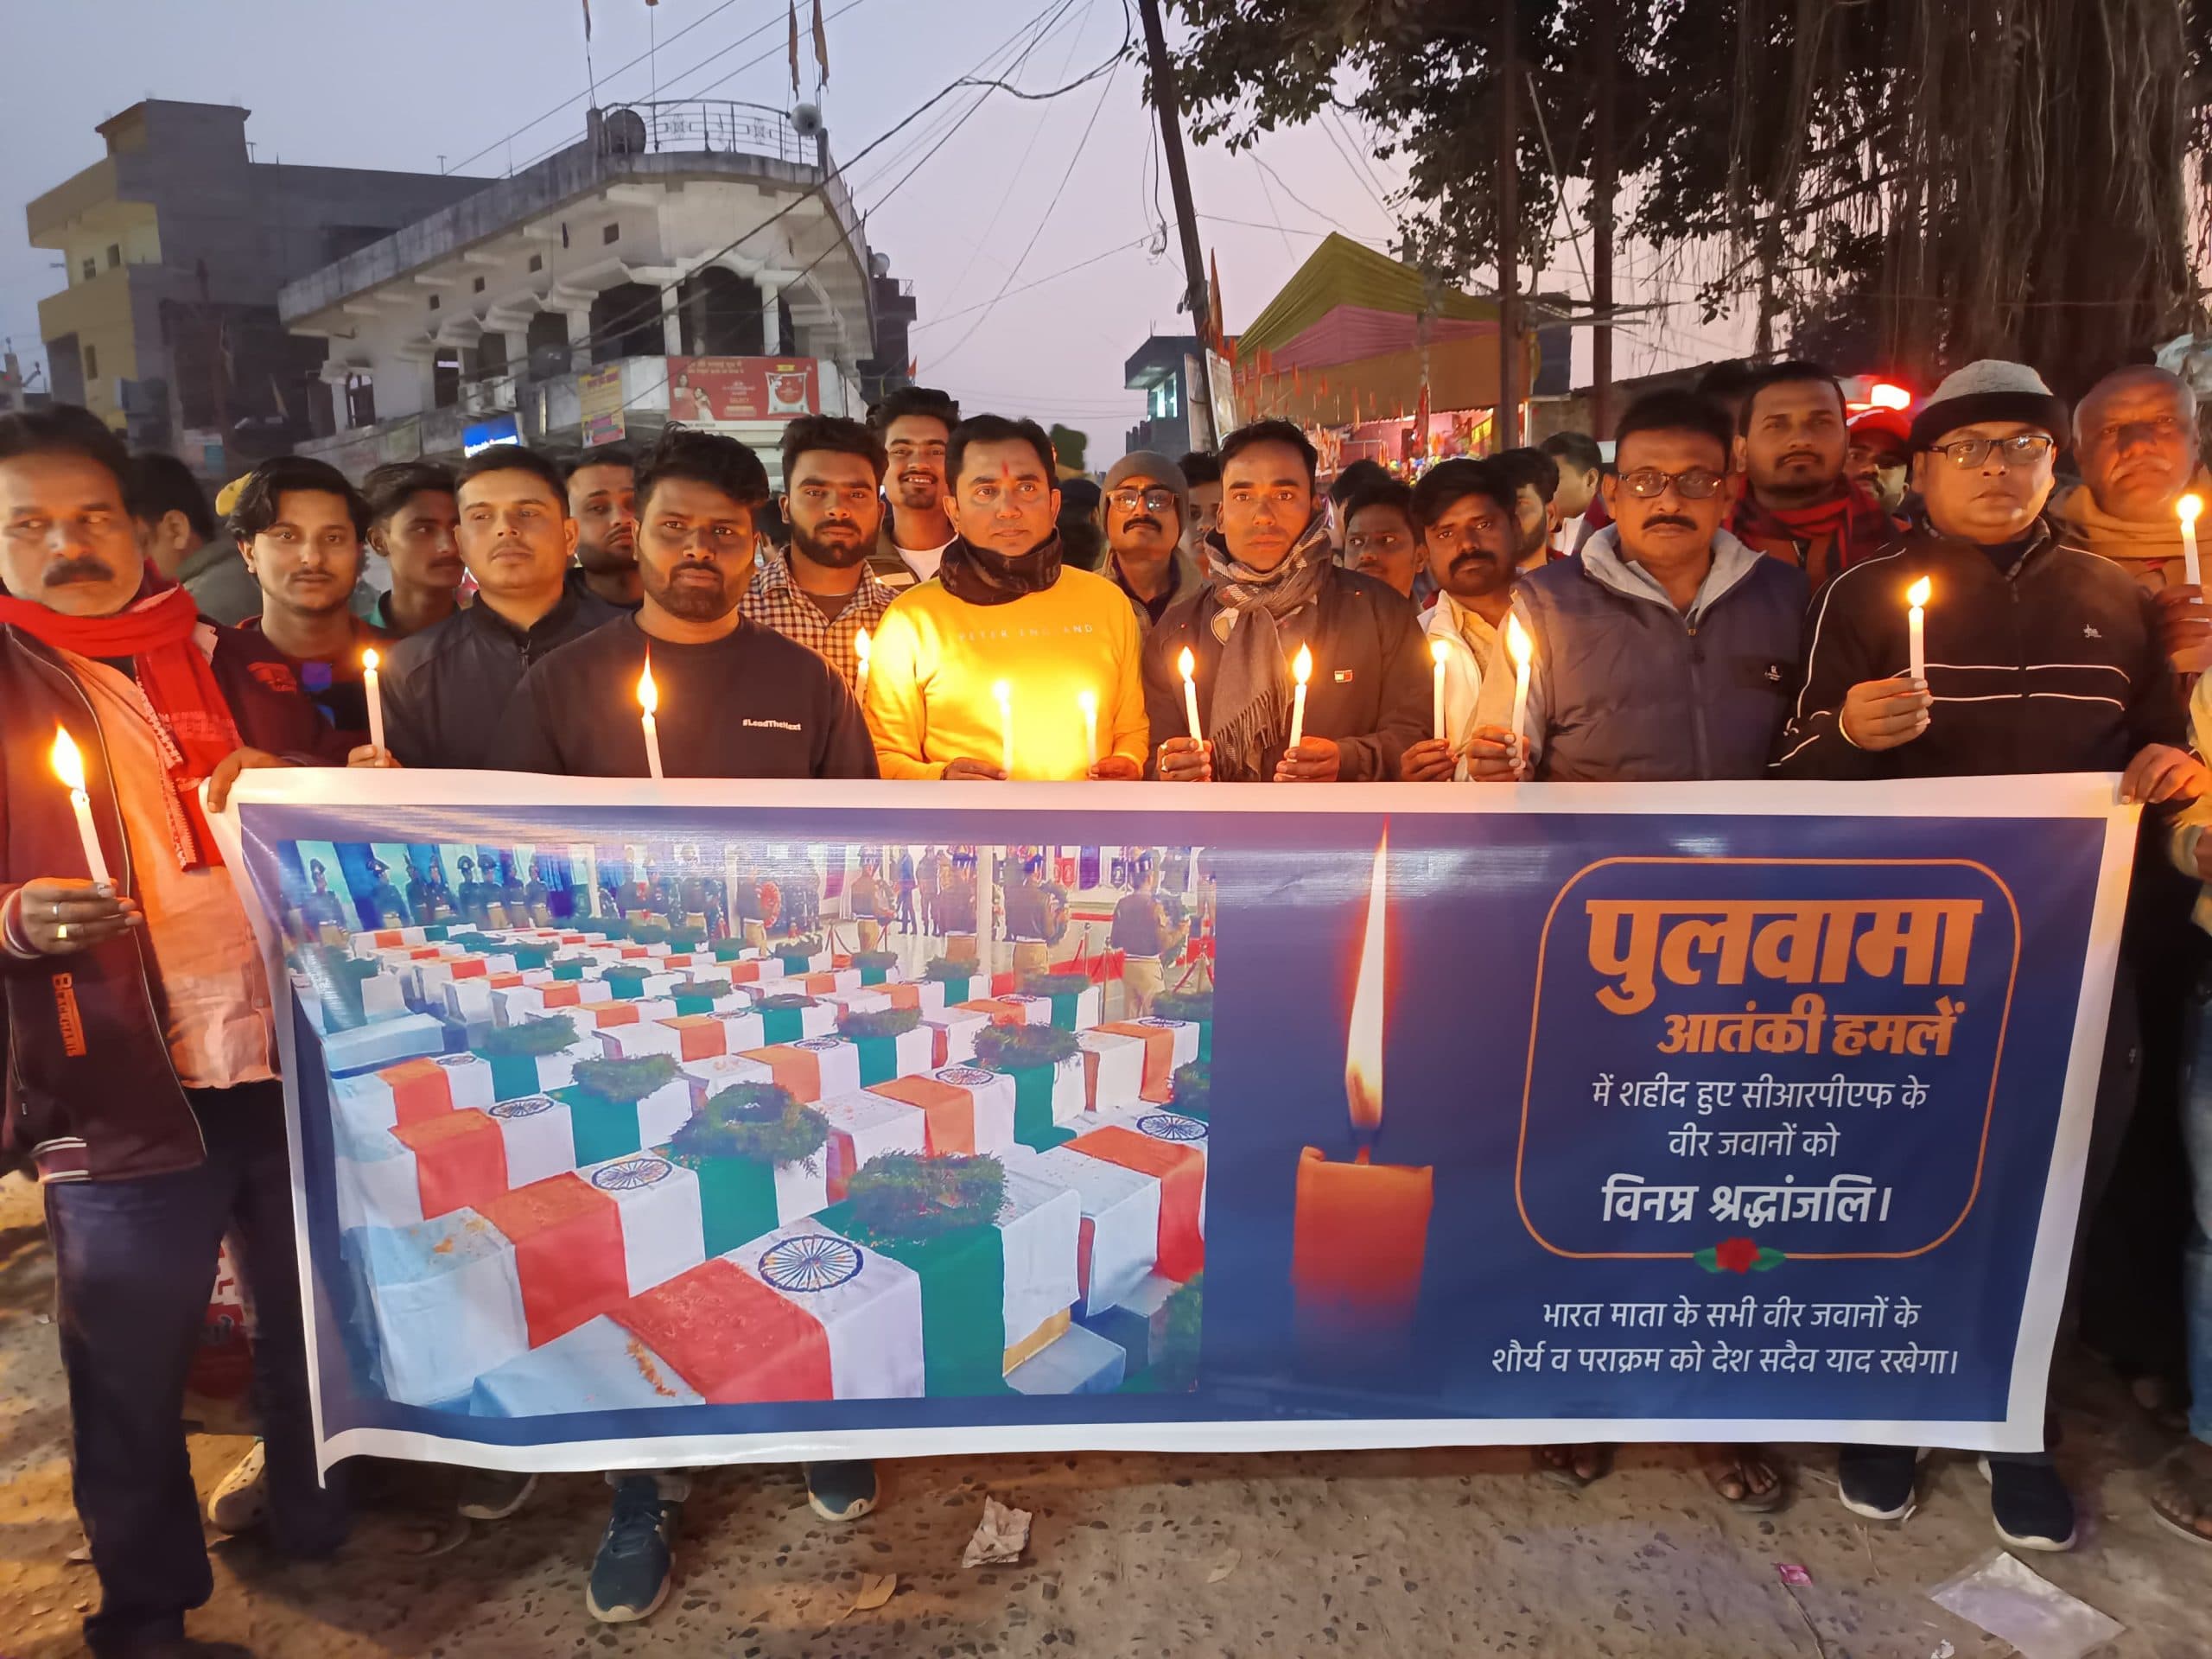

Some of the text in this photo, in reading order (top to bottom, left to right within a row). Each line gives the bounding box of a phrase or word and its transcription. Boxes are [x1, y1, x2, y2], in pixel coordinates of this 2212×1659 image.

[1586, 899, 1983, 1015] पुलवामा
[1656, 993, 1965, 1055] आतंकी हमलें
[1592, 1072, 1930, 1116] में शहीद हुए सीआरपीएफ के
[1668, 1122, 1841, 1157] वीर जवानों को
[1601, 1173, 1892, 1229] विनम्र श्रद्धांजलि।
[1543, 1294, 1923, 1328] भारत माता के सभी वीर जवानों के
[1491, 1339, 1958, 1374] शौर्य व पराक्रम को देश सदैव याद रखेगा।
